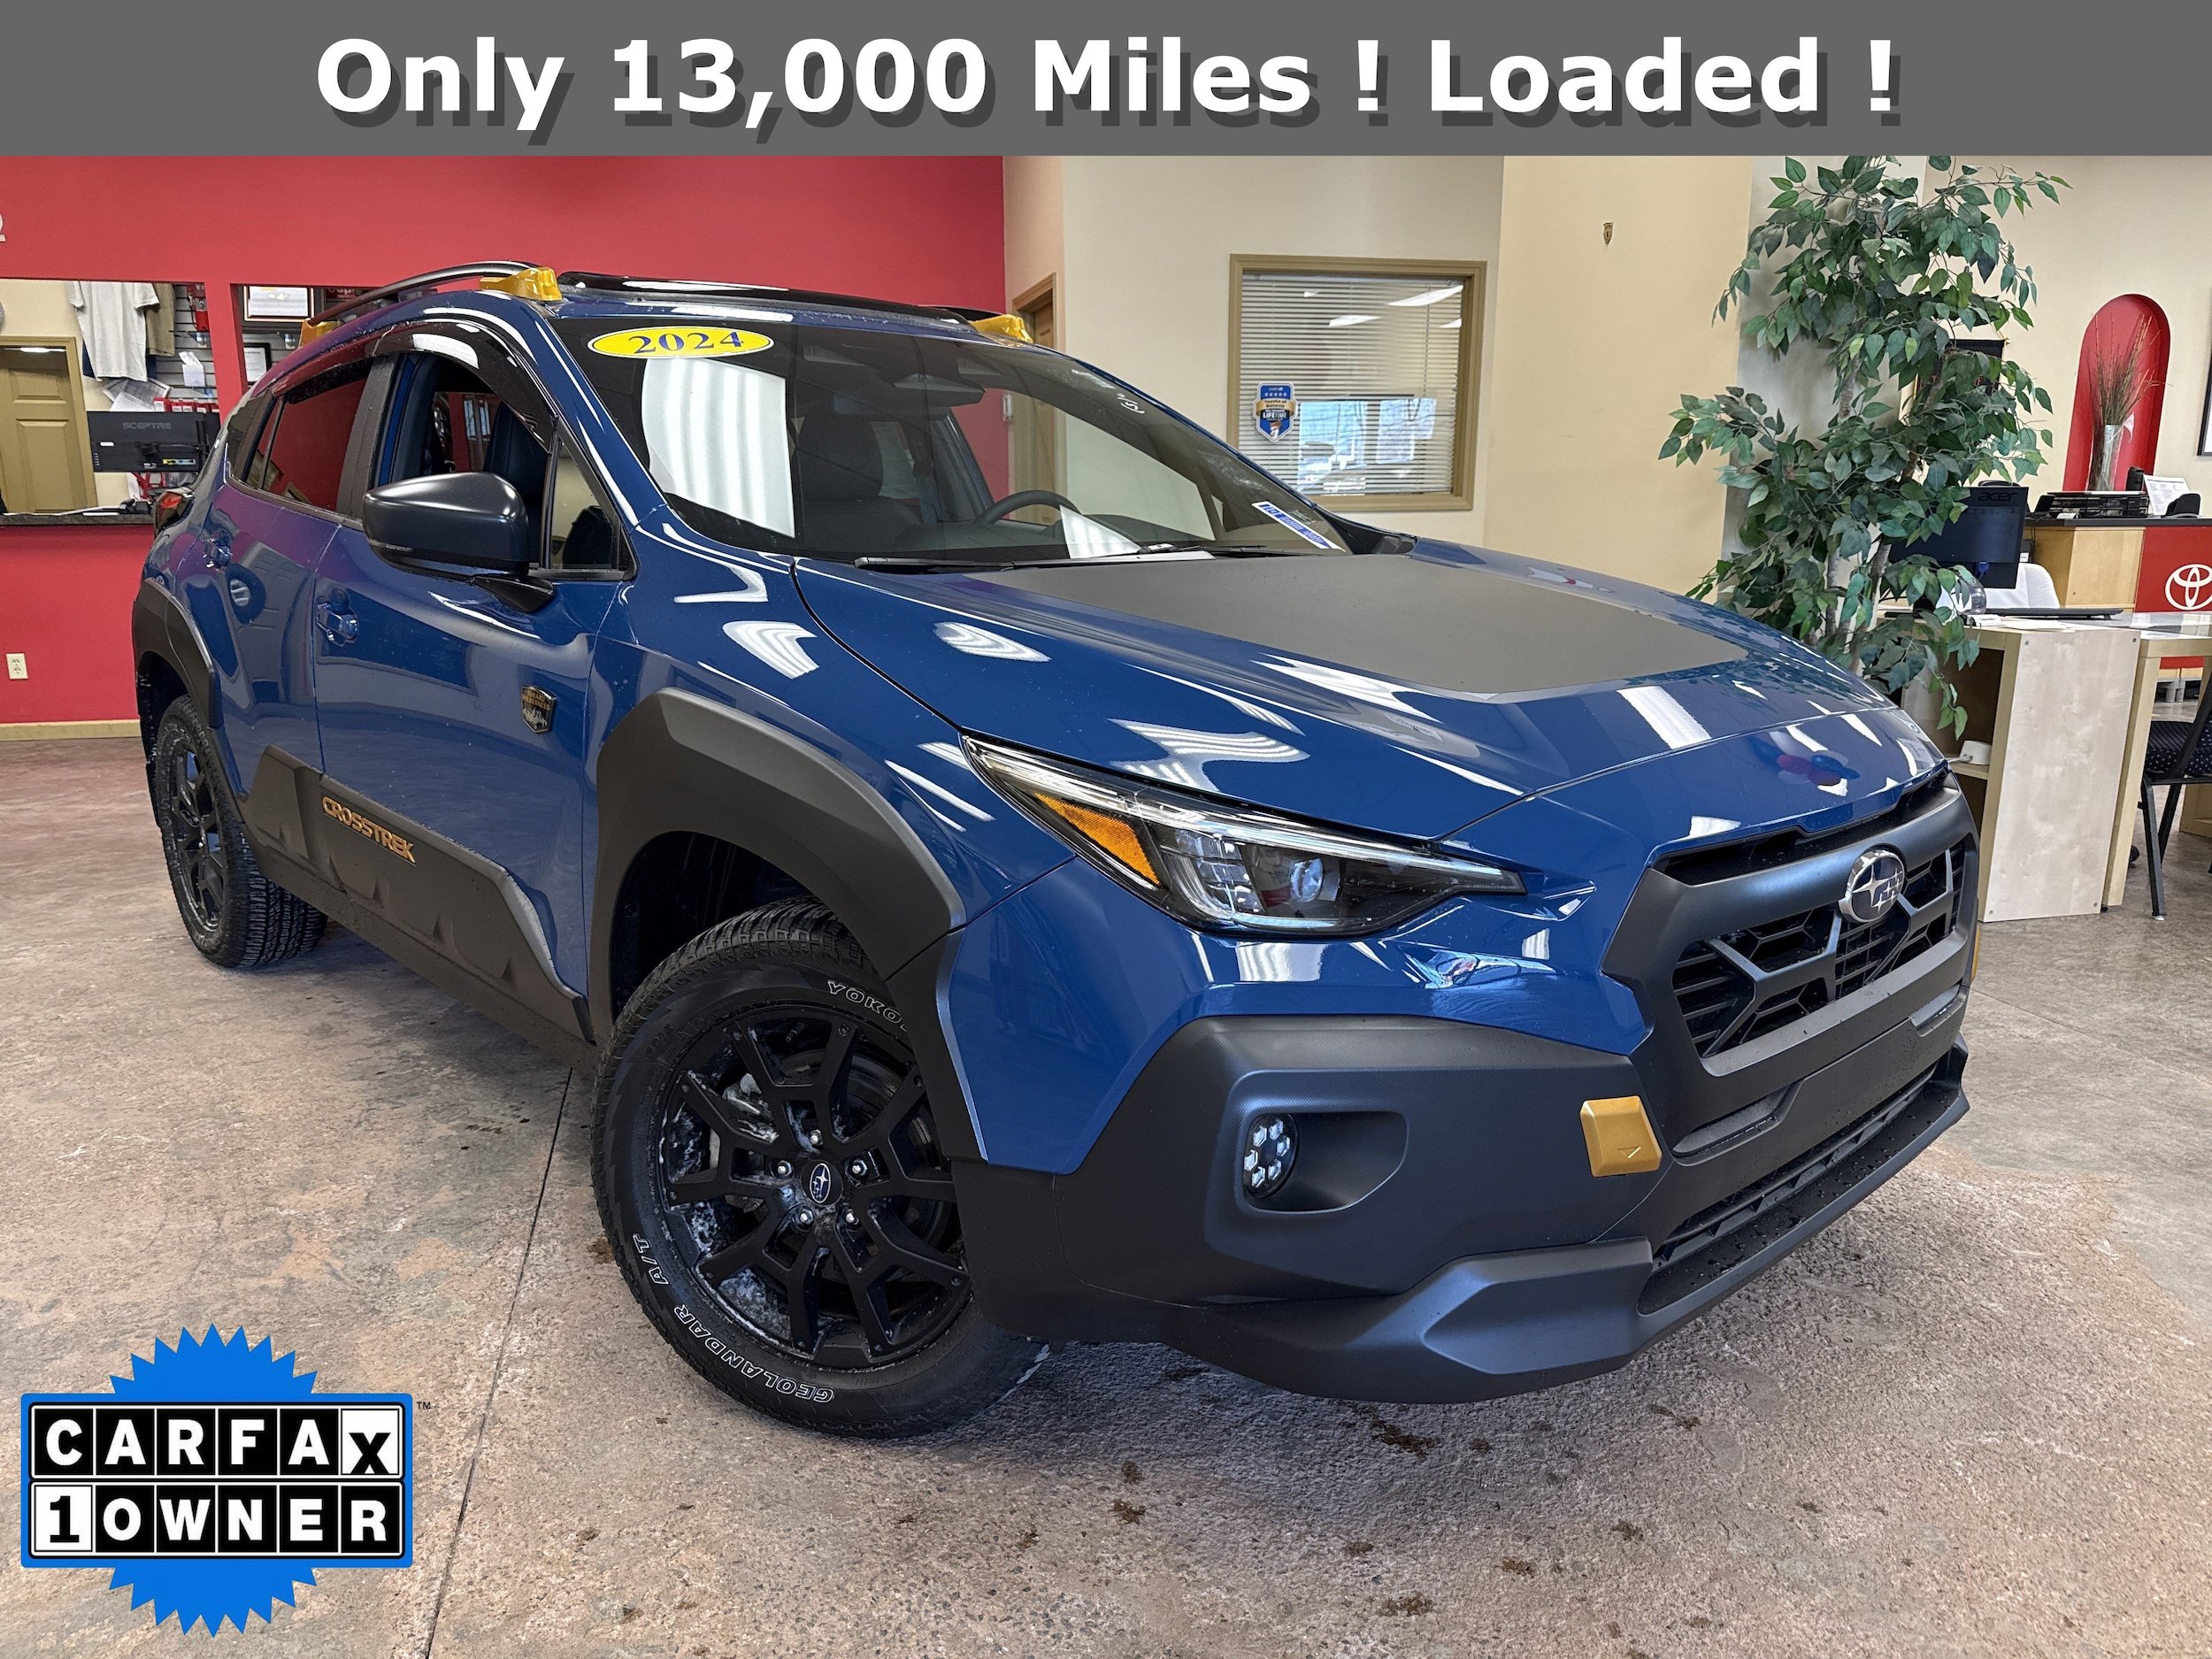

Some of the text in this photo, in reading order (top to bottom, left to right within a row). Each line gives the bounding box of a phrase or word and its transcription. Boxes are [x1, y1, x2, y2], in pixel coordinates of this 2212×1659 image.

[628, 331, 745, 354] 2024
[122, 421, 172, 430] SCEPTRE
[1978, 491, 2017, 502] acer
[322, 796, 416, 864] CROSSTREK
[827, 979, 907, 1033] YOKO
[633, 1233, 670, 1285] A/T
[673, 1304, 835, 1404] GEOLANDAR
